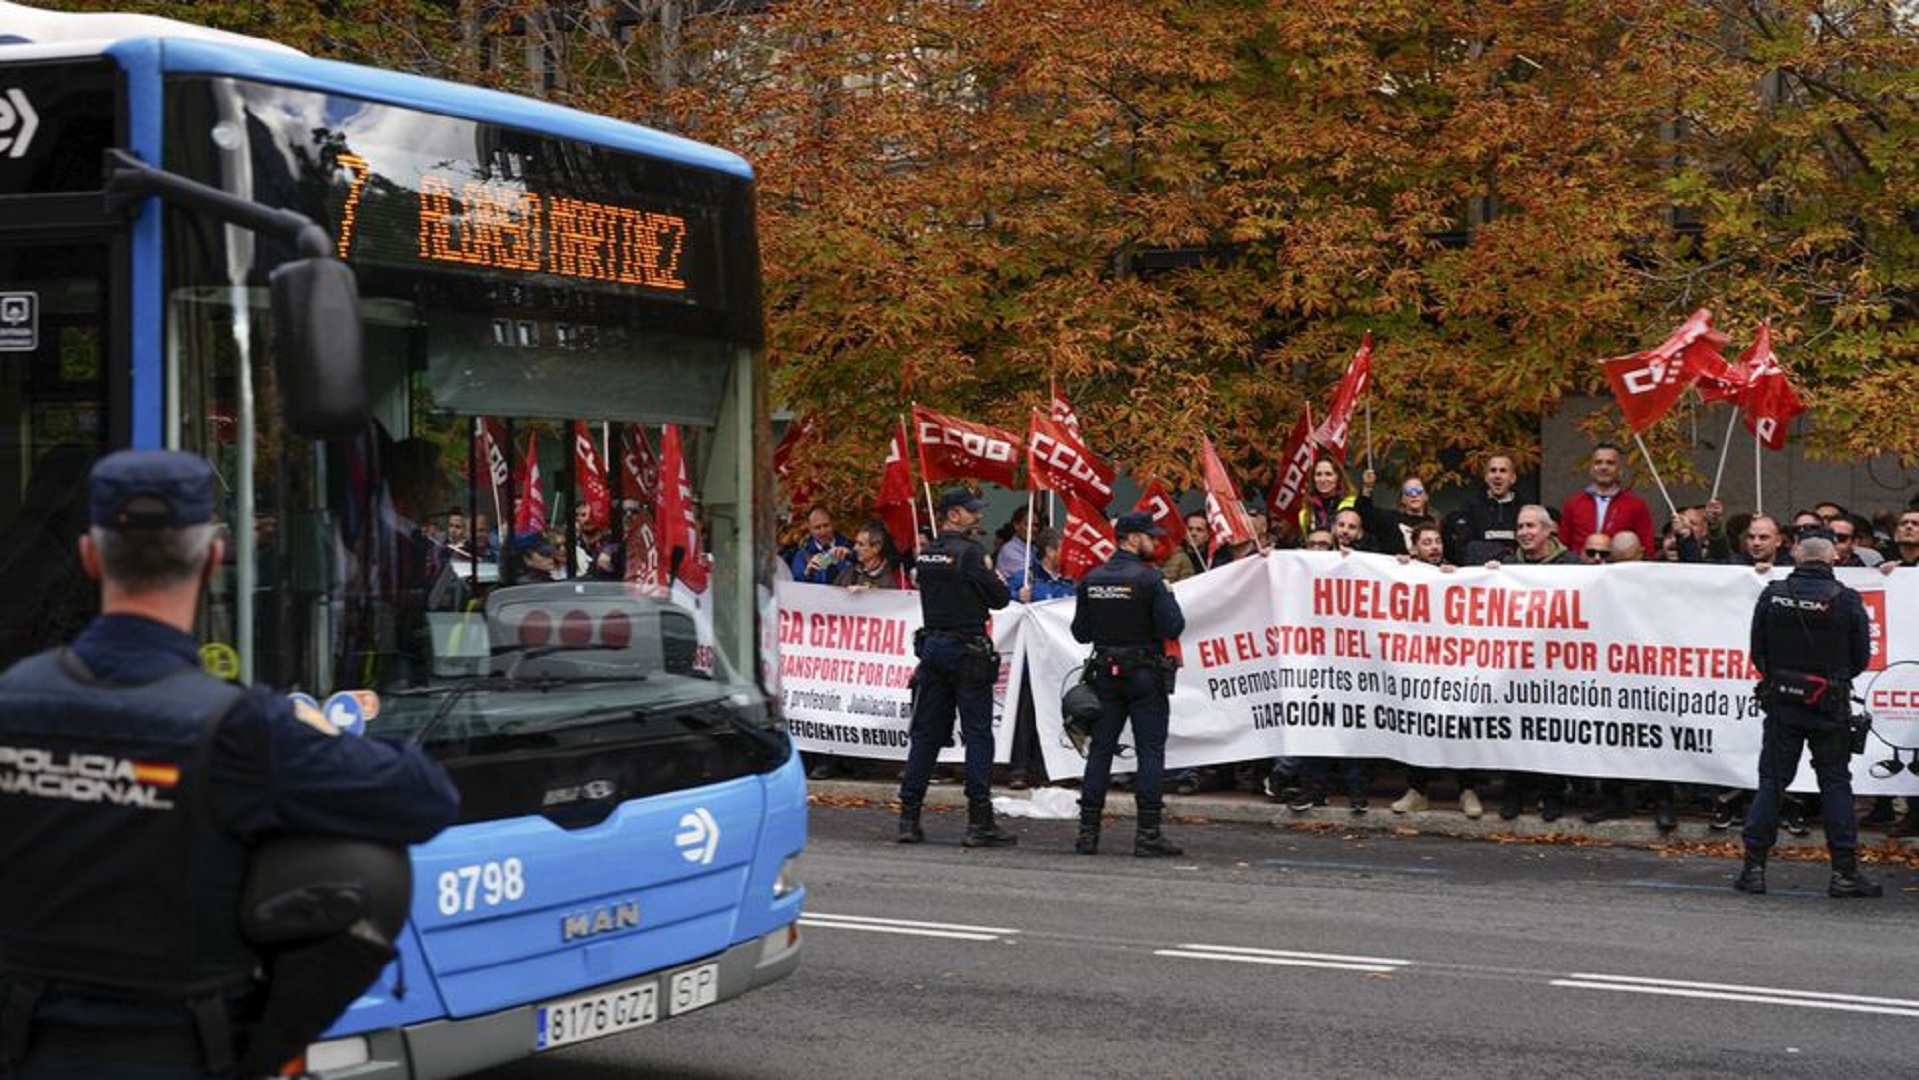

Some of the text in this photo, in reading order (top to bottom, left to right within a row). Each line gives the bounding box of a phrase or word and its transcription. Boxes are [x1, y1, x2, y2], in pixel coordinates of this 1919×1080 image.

[337, 153, 369, 259] 7
[549, 196, 686, 290] MARTINEZ
[920, 421, 1012, 463] CCOO
[1313, 577, 1590, 630] HUELGA GENERAL
[779, 608, 906, 656] GA GENERAL
[1198, 637, 1230, 668] EN
[1234, 631, 1262, 661] EL
[1335, 627, 1371, 659] DEL
[1378, 631, 1536, 670] TRANSPORTE
[1546, 641, 1597, 671] POR
[1607, 643, 1763, 680] CARRETERA
[857, 660, 883, 687] POR
[1208, 667, 1759, 720] Paremos muertes en la profesión. Jubilación anticipada ya
[1342, 703, 1367, 729] DE
[1373, 704, 1512, 740] COEFICIENTES
[1520, 715, 1663, 749] REDUCTORES
[1670, 725, 1713, 754] YA!!
[438, 857, 524, 916] 8798
[561, 901, 640, 943] MAN
[551, 969, 714, 1041] 8176 GZZ SP
